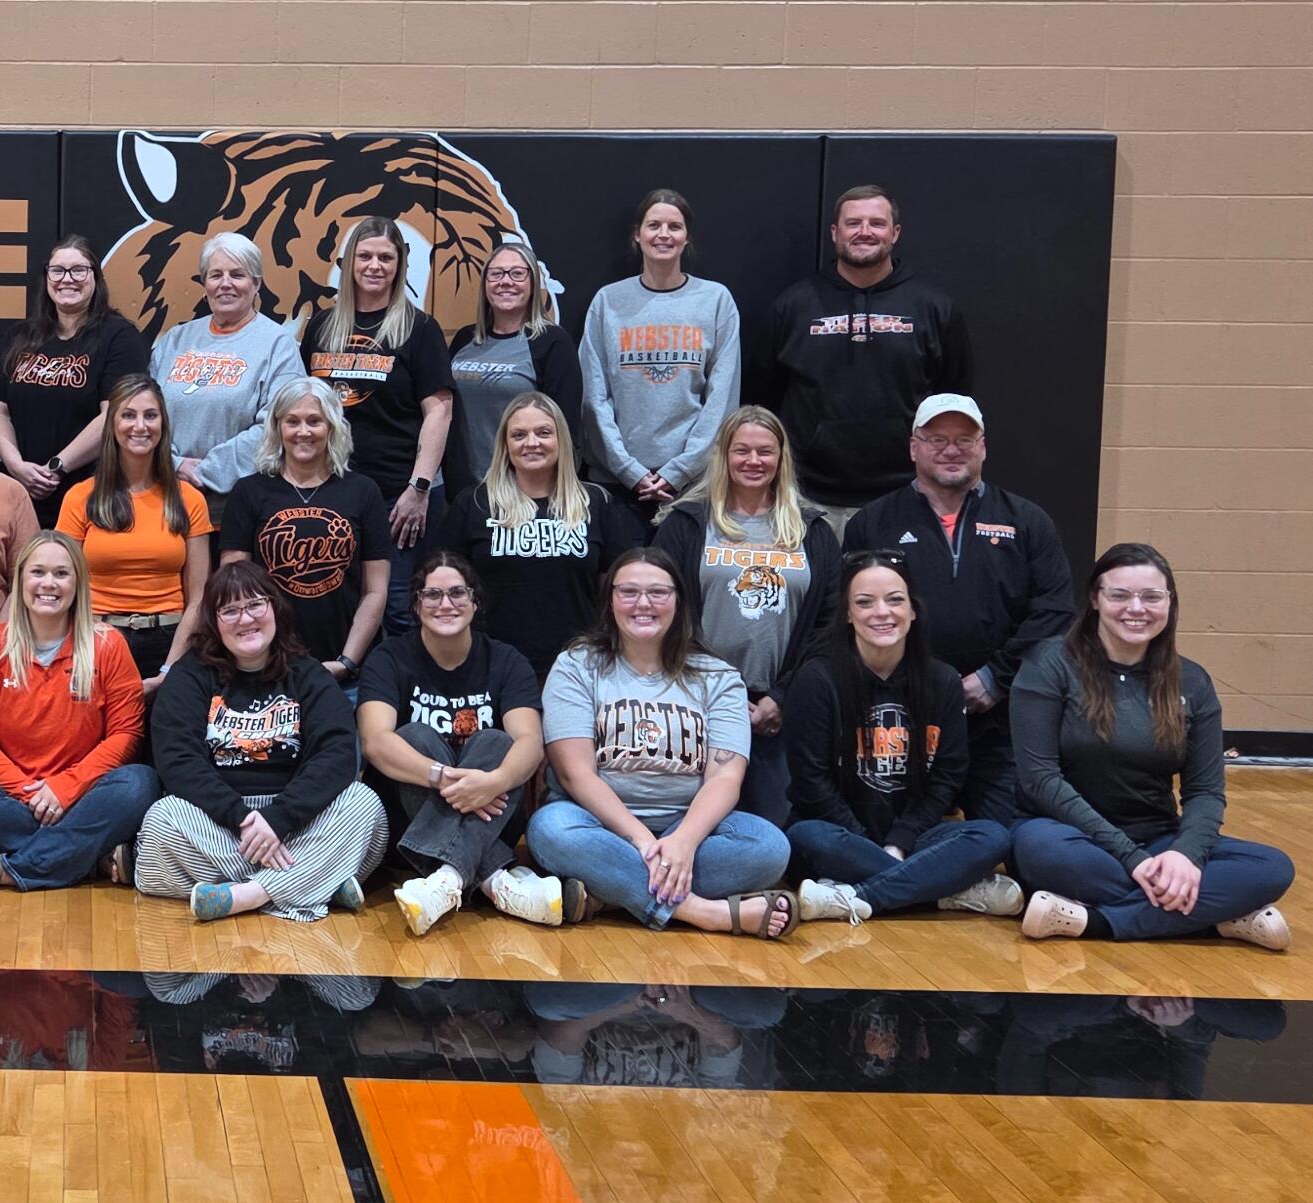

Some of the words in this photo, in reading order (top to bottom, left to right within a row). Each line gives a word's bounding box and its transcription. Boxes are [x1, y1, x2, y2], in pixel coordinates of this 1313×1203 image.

[619, 325, 704, 351] WEBSTER
[451, 361, 517, 373] WEBSTER
[620, 352, 702, 362] BASKETBALL
[260, 525, 356, 574] Tigers
[486, 518, 589, 558] TIGERS
[704, 546, 807, 571] TIGERS
[450, 696, 466, 708] TO
[467, 694, 485, 706] BE
[214, 705, 266, 731] WEBSTER
